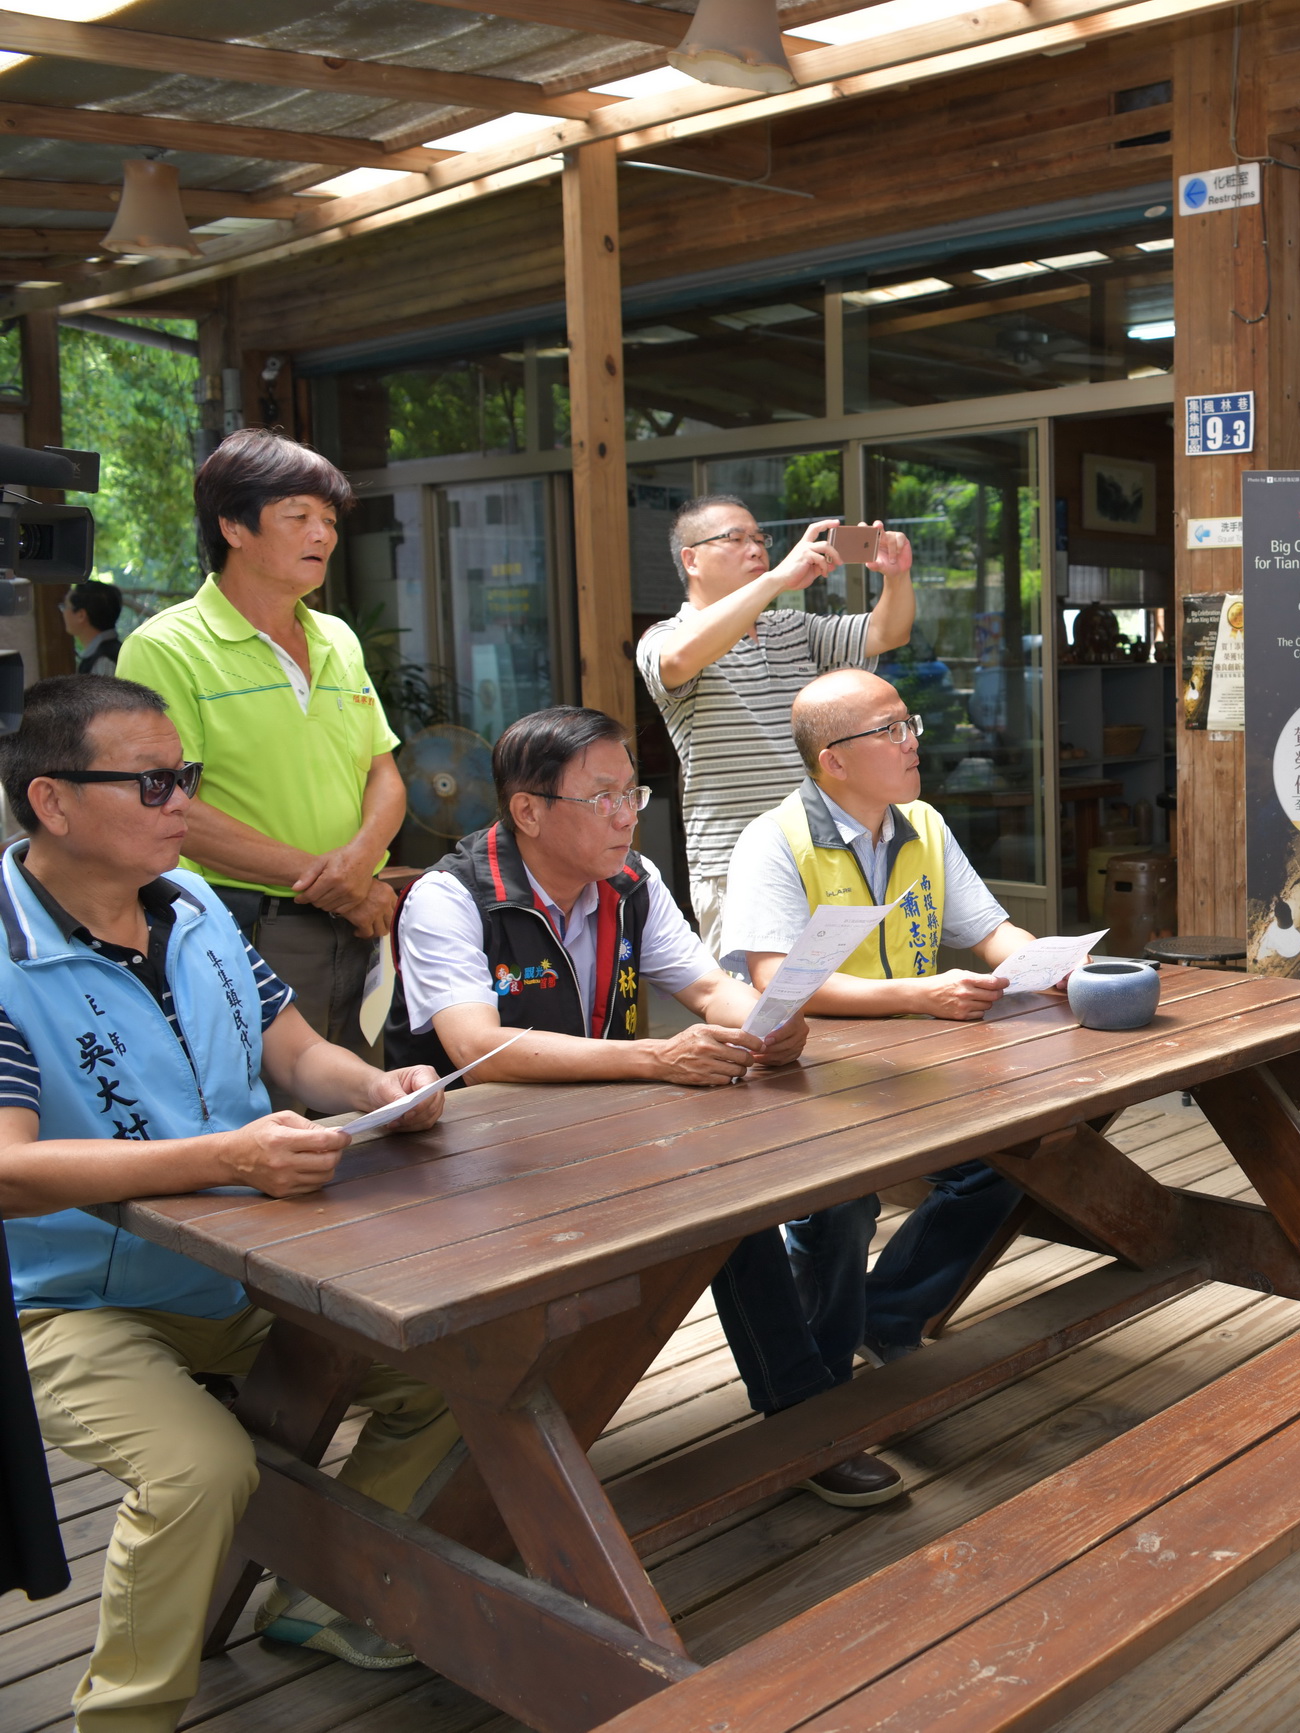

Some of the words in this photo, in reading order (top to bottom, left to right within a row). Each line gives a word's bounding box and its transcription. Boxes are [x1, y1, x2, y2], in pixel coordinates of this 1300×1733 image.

[1208, 191, 1255, 205] Restrooms
[1270, 540, 1291, 555] Big
[1254, 556, 1272, 570] for
[1274, 556, 1300, 569] Tian
[1277, 637, 1293, 647] The
